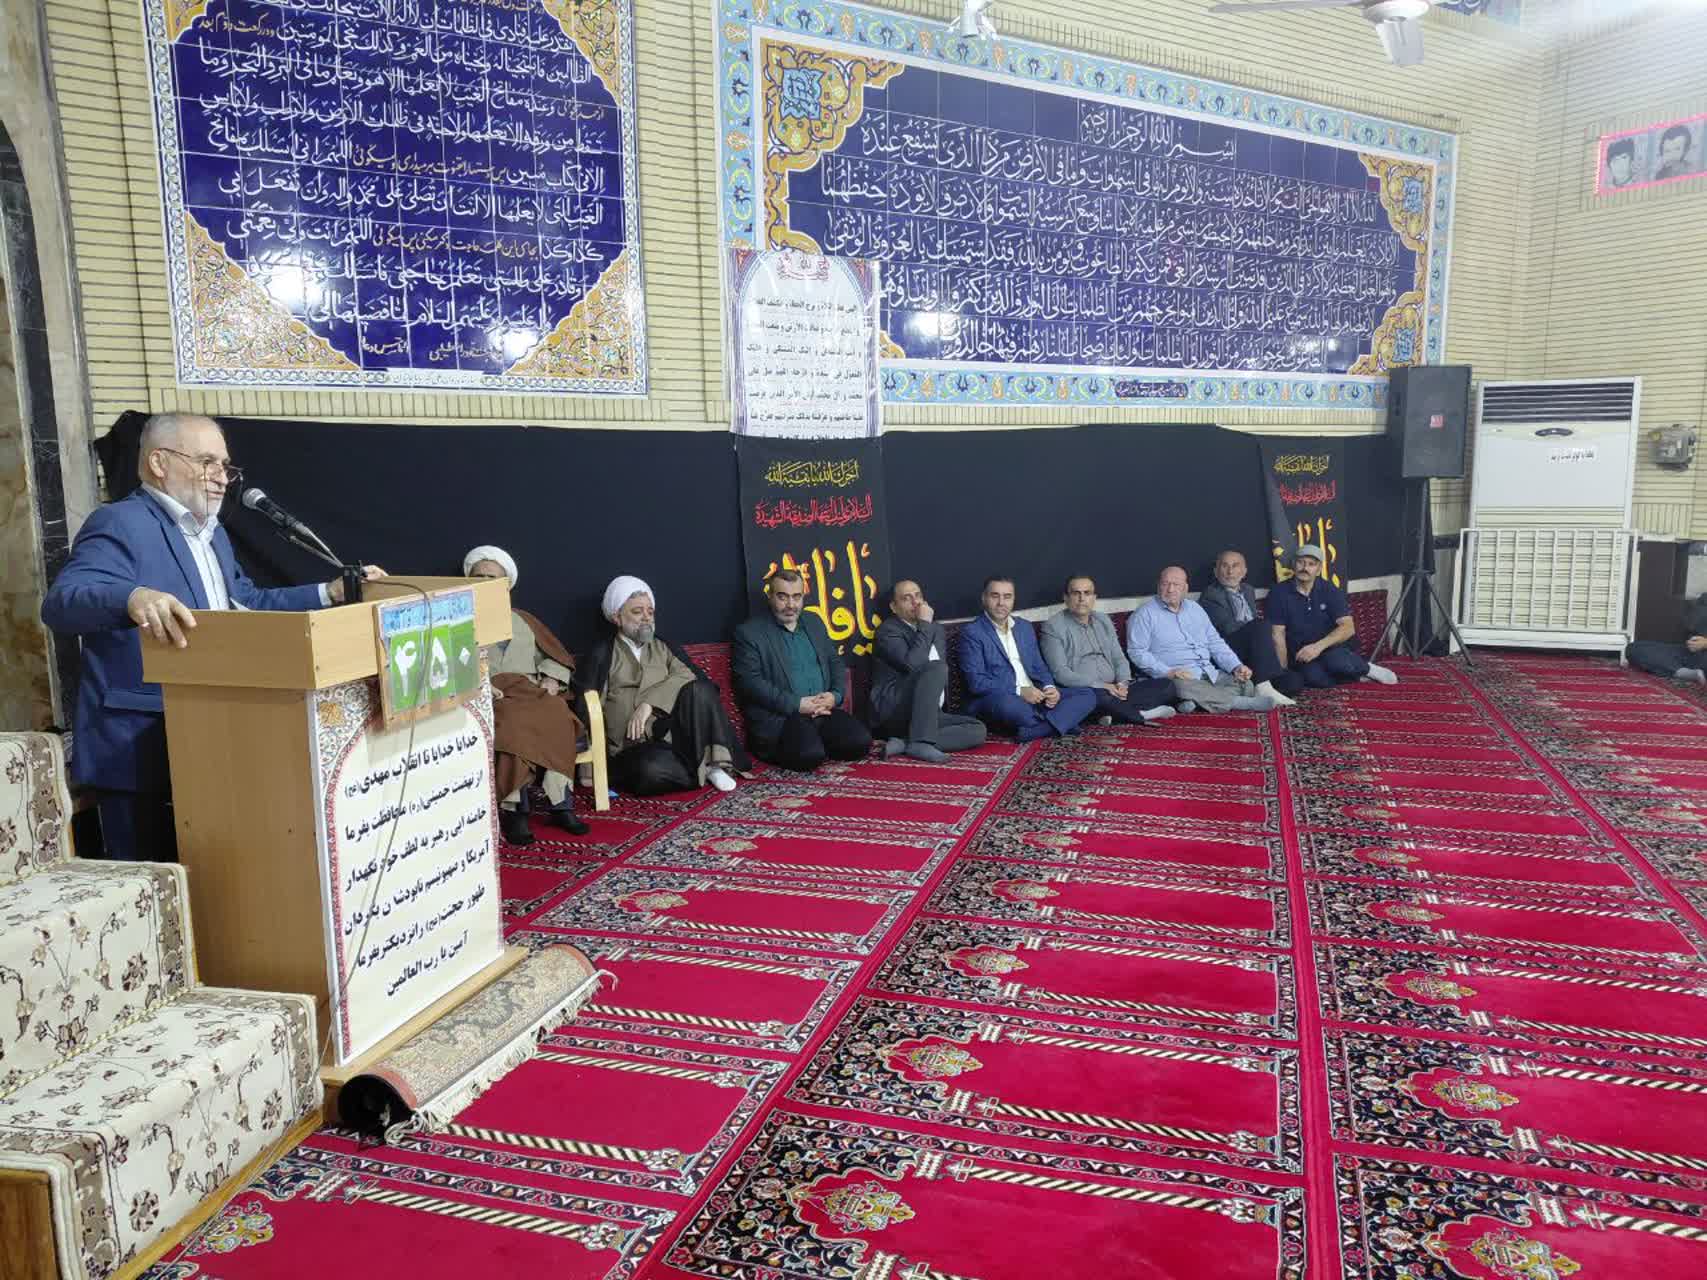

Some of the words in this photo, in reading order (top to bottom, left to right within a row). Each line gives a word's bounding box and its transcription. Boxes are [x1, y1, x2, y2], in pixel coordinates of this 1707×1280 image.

[394, 637, 471, 697] ۴۵۰
[432, 743, 454, 765] خدایا
[456, 733, 478, 755] خدایا
[392, 752, 421, 779] انقلاب
[423, 750, 431, 765] تا
[475, 769, 484, 787] از
[372, 804, 407, 830] محافظت
[400, 838, 418, 859] لطف
[420, 836, 429, 849] به
[431, 826, 449, 849] رهبر
[466, 839, 490, 864] آمریکا
[345, 858, 378, 892] نگهدار
[460, 859, 466, 873] و
[467, 883, 486, 910] ظهور
[440, 945, 447, 961] یا
[448, 929, 468, 958] آمین
[423, 956, 439, 971] رب
[387, 959, 422, 997] العالمین
